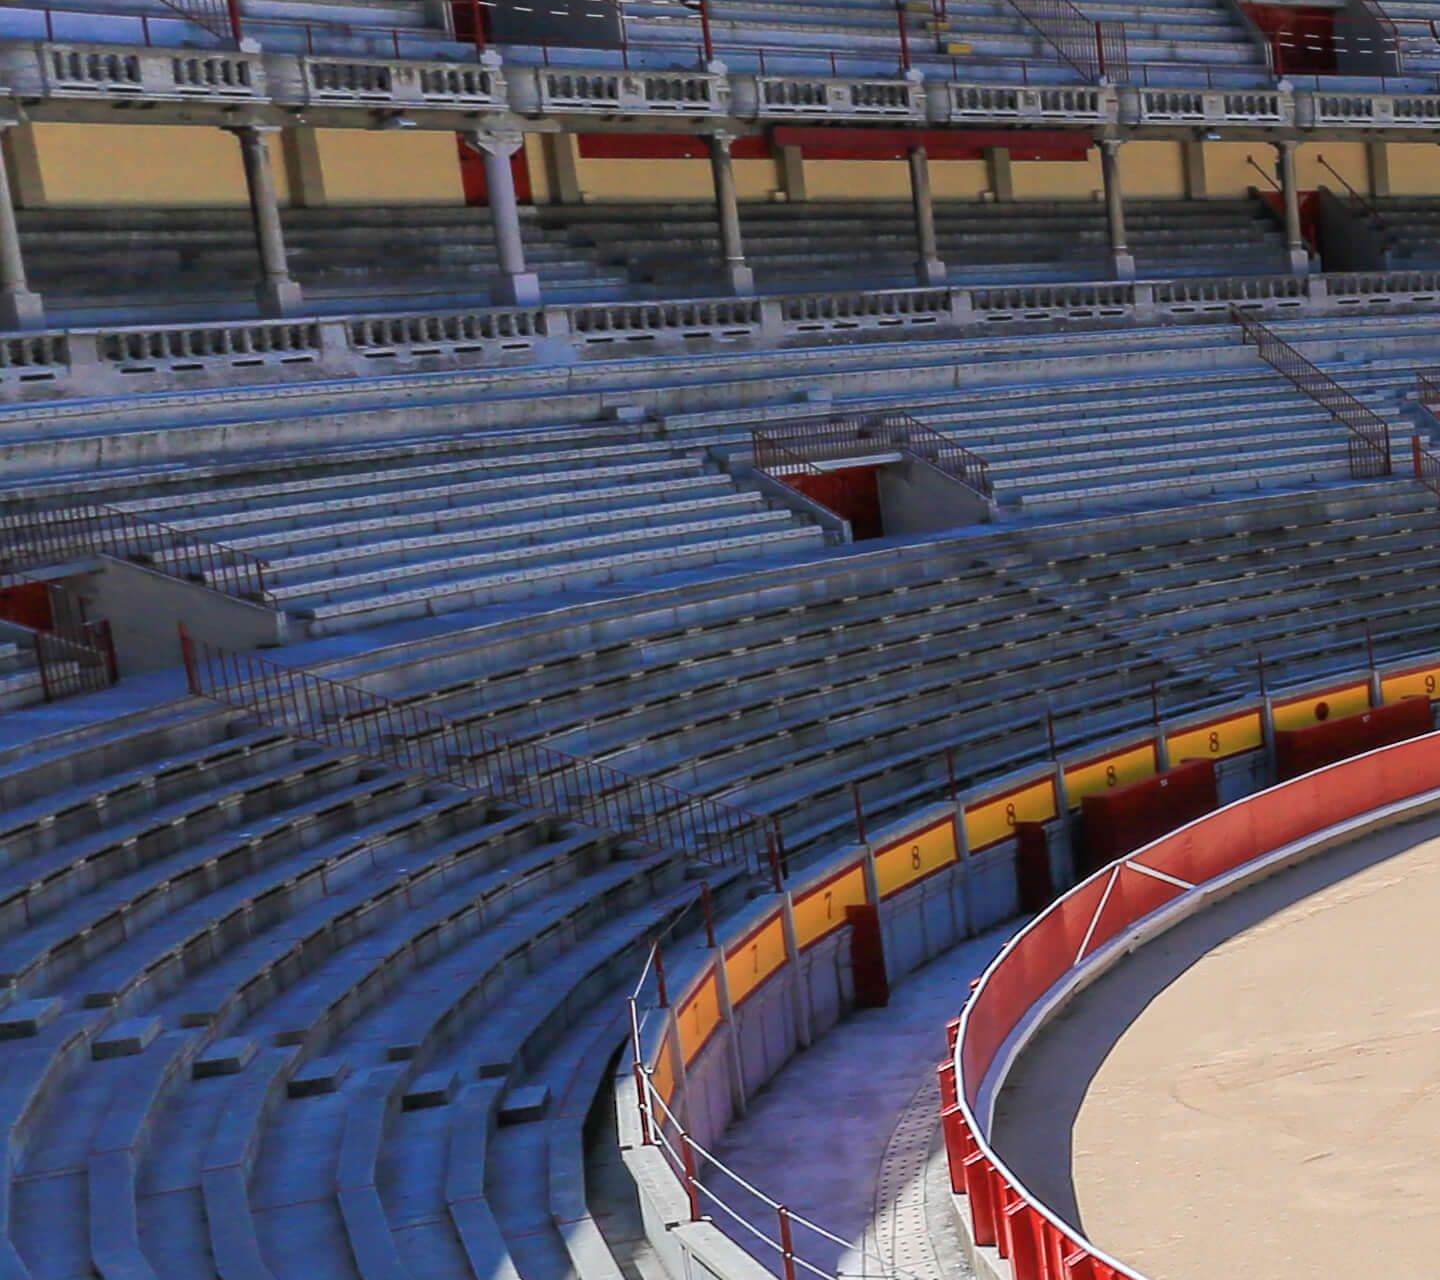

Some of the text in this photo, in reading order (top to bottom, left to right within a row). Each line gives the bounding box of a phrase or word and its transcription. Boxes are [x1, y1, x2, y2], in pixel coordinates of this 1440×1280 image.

[1424, 675, 1435, 694] 9
[1209, 731, 1219, 753] 8
[1106, 765, 1117, 788] 8
[1006, 803, 1016, 826] 8
[911, 846, 920, 870] 8
[824, 891, 832, 920] 7
